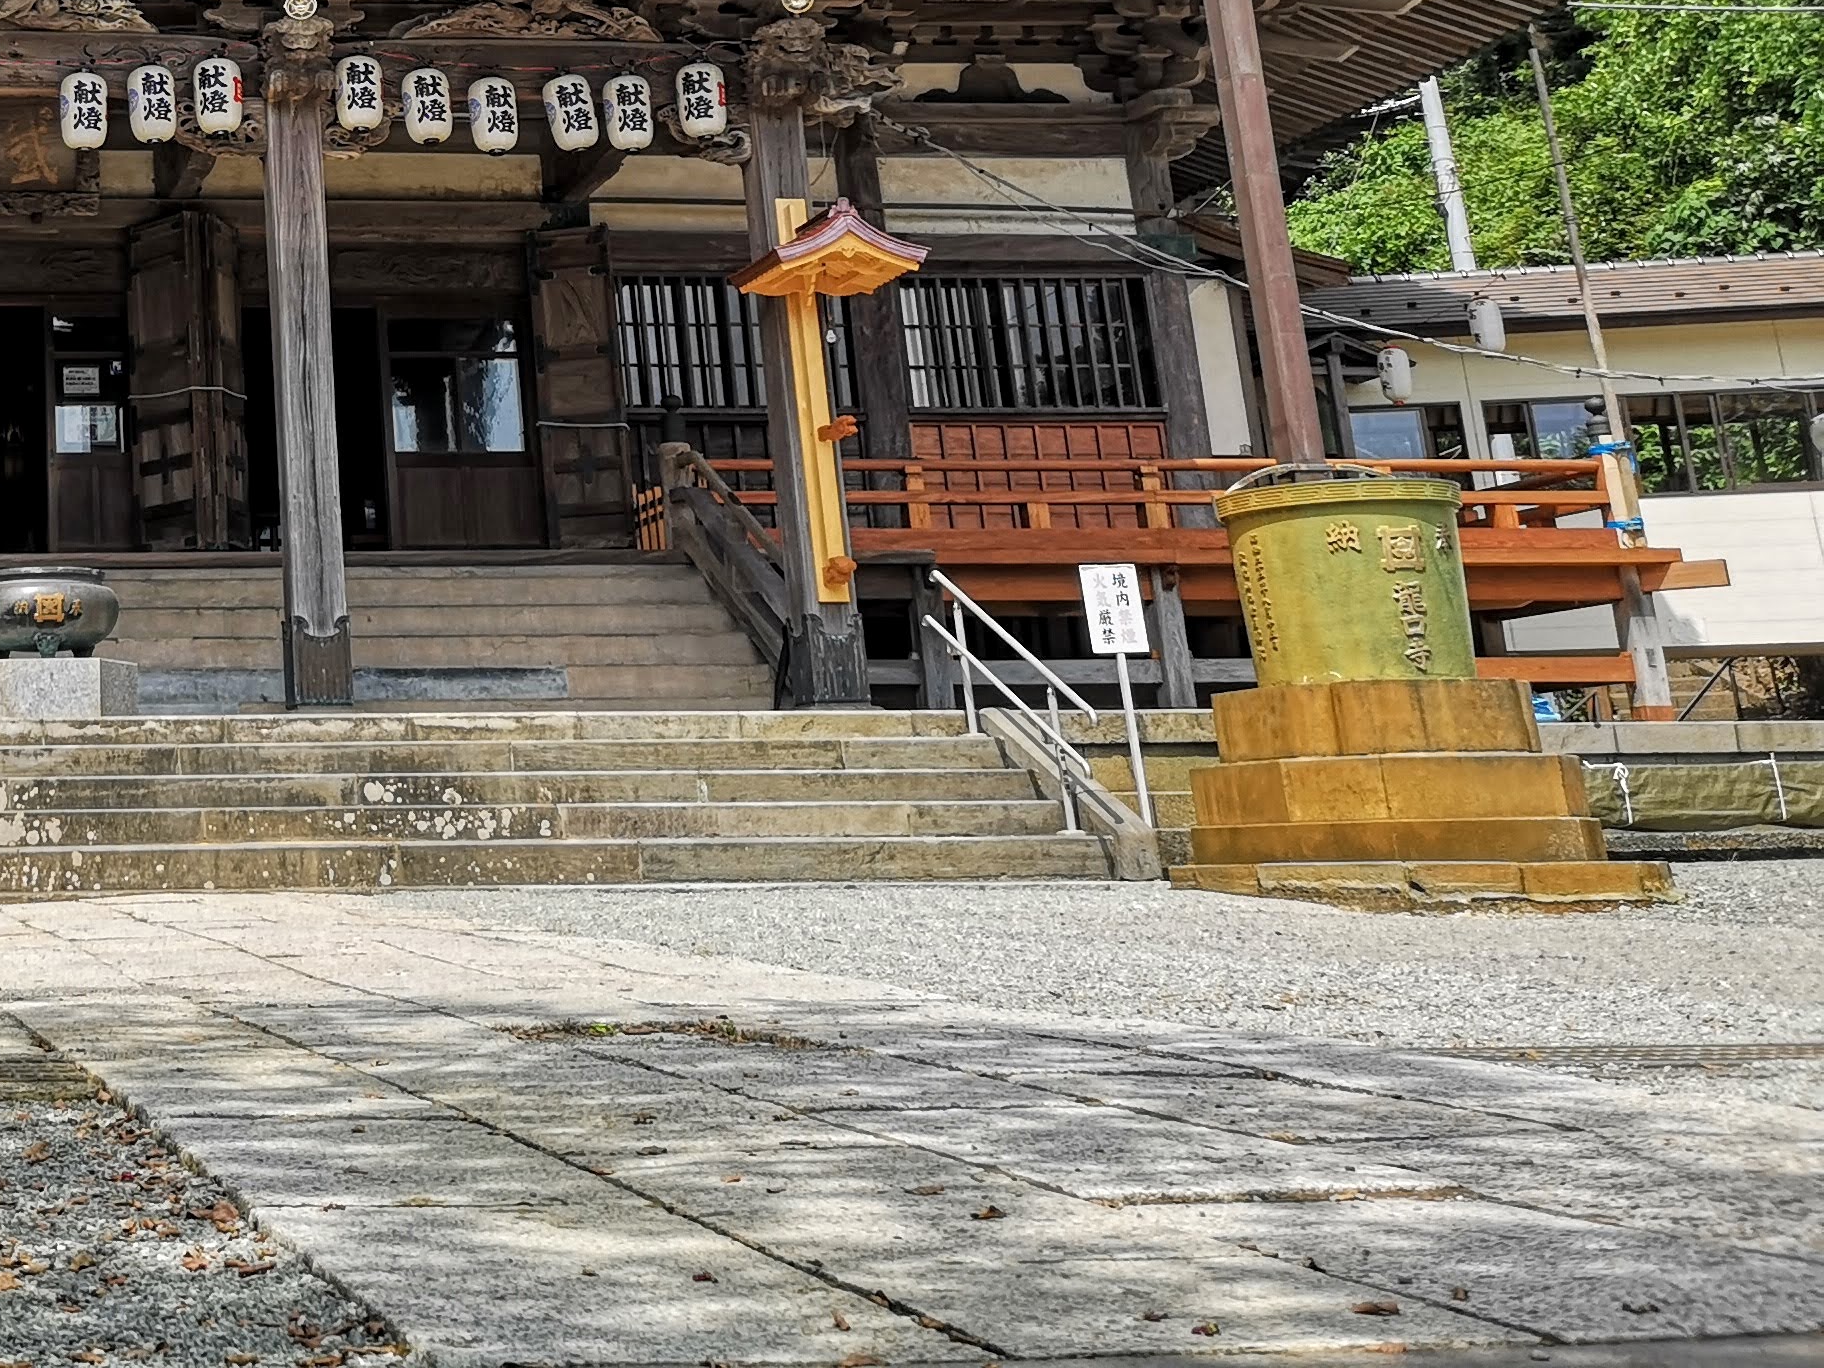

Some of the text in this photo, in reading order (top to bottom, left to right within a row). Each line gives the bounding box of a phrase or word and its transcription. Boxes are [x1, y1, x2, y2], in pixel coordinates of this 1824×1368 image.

[74, 80, 102, 131] 献燈
[142, 73, 172, 122] 献燈
[198, 65, 229, 115] 献燈
[346, 62, 377, 109] 献燈
[414, 75, 447, 123] 献燈
[485, 85, 515, 134] 献燈
[556, 83, 592, 133] 献燈
[616, 83, 648, 132] 献燈
[681, 71, 714, 121] 献燈
[1326, 520, 1363, 555] 納
[1092, 573, 1116, 644] 火気厳禁
[1112, 572, 1137, 644] 境内禁煙
[1392, 580, 1432, 673] 龍口寺
